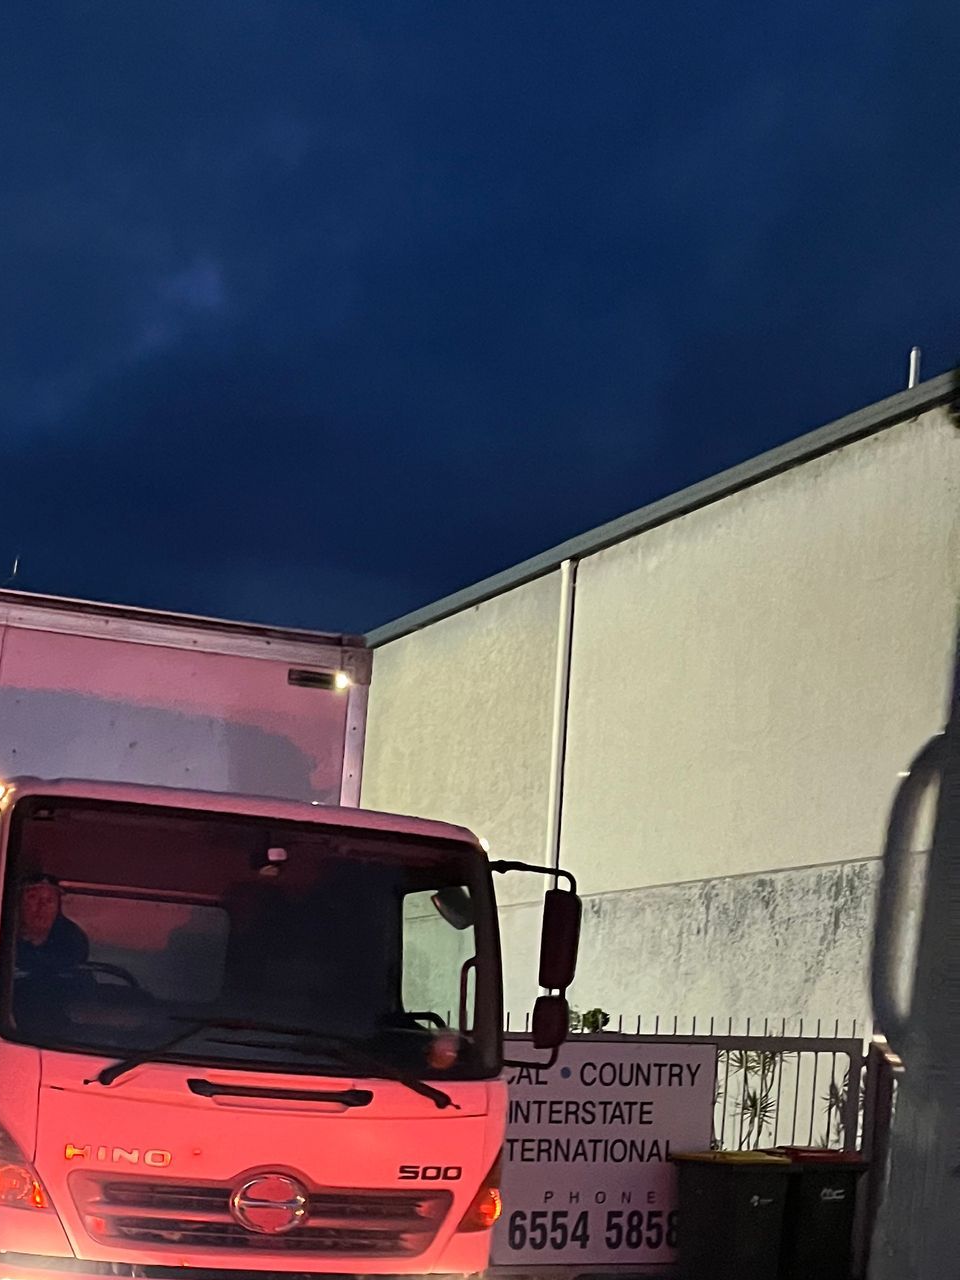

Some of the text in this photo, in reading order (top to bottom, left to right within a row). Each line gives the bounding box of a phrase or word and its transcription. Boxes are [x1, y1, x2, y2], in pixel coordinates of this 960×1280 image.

[507, 1061, 702, 1087] AL COUNTRY
[508, 1101, 654, 1125] INTERSTATE
[64, 1142, 172, 1168] HINO
[506, 1138, 674, 1163] TERNATIONAL
[397, 1164, 463, 1182] 500
[543, 1191, 657, 1204] PHONE
[508, 1210, 680, 1251] 6554 5858
